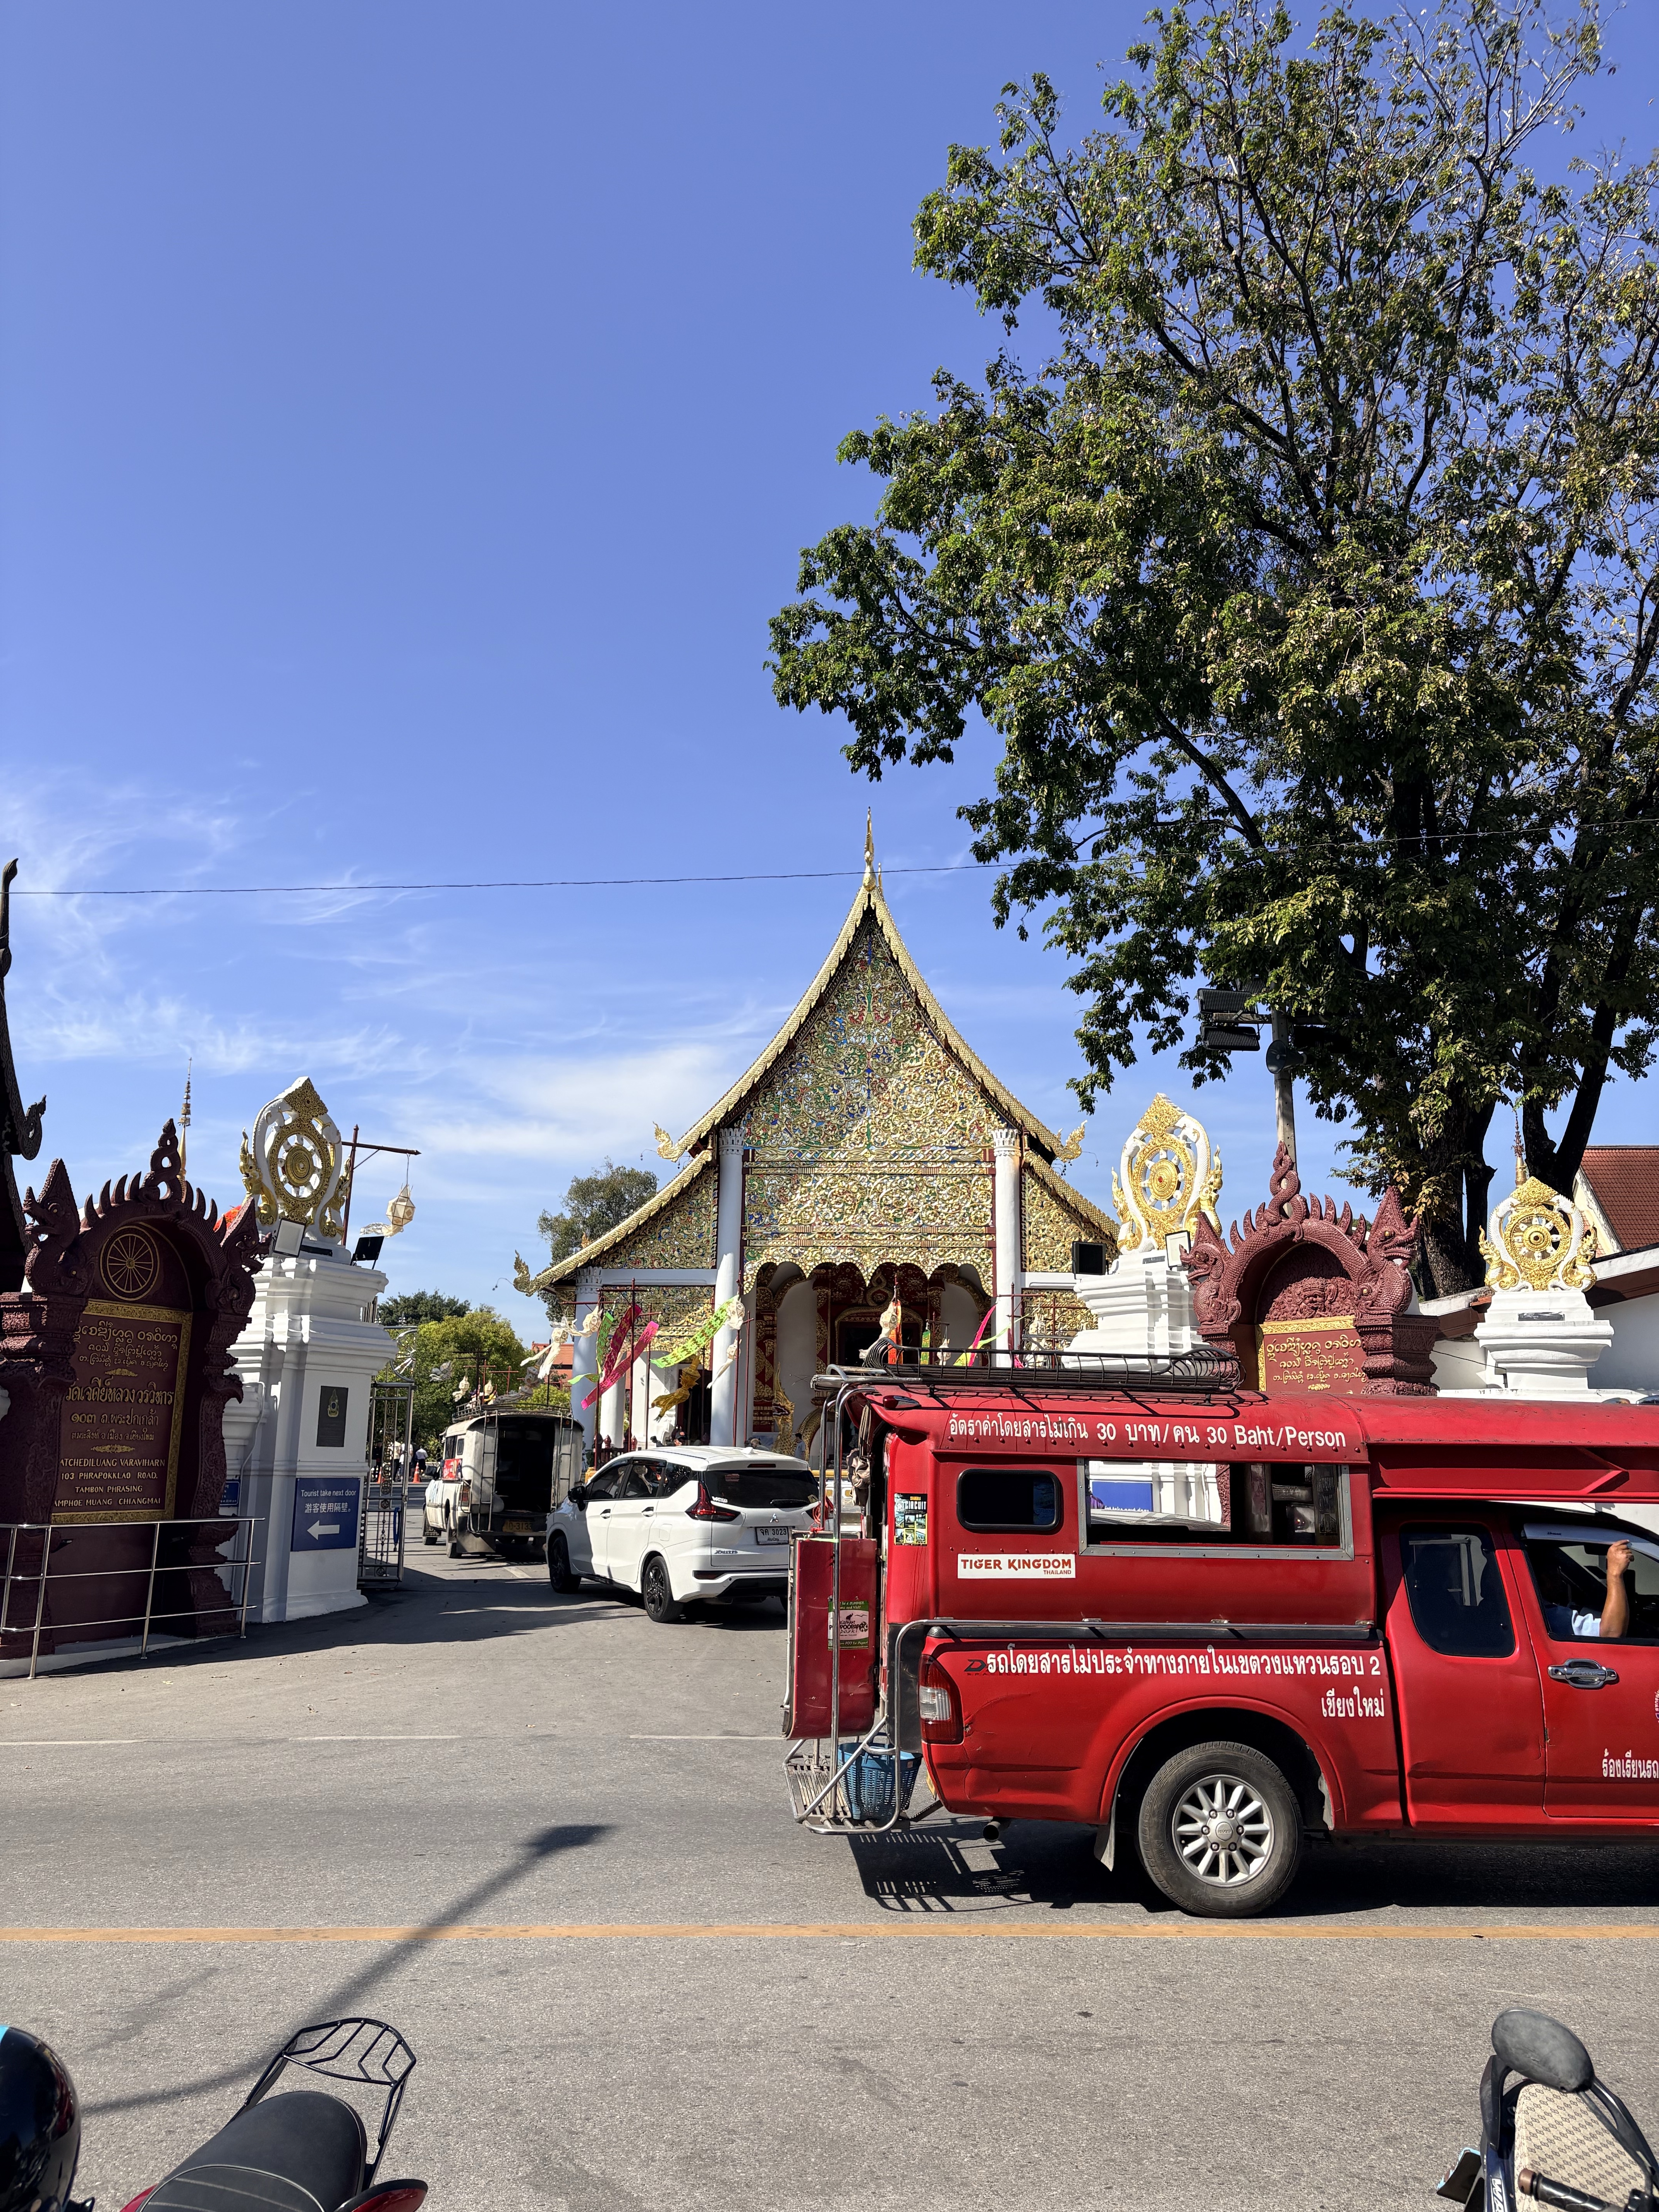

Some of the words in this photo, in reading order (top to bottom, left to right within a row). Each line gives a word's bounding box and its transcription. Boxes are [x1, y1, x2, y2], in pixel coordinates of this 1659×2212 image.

[949, 1413, 1088, 1439] อัตราค่าโดยสารไม่เกิน
[1097, 1423, 1116, 1440] 30
[1206, 1426, 1227, 1444] 30
[1234, 1425, 1346, 1447] Baht/Person
[60, 1458, 117, 1467] ATCHEDILUANG
[120, 1458, 165, 1467] VARAVIHARN
[961, 1559, 1002, 1570] TIGER
[1008, 1559, 1071, 1571] KINGDOM
[1369, 1656, 1381, 1675] 2
[1321, 1686, 1385, 1717] เชียงใหม่
